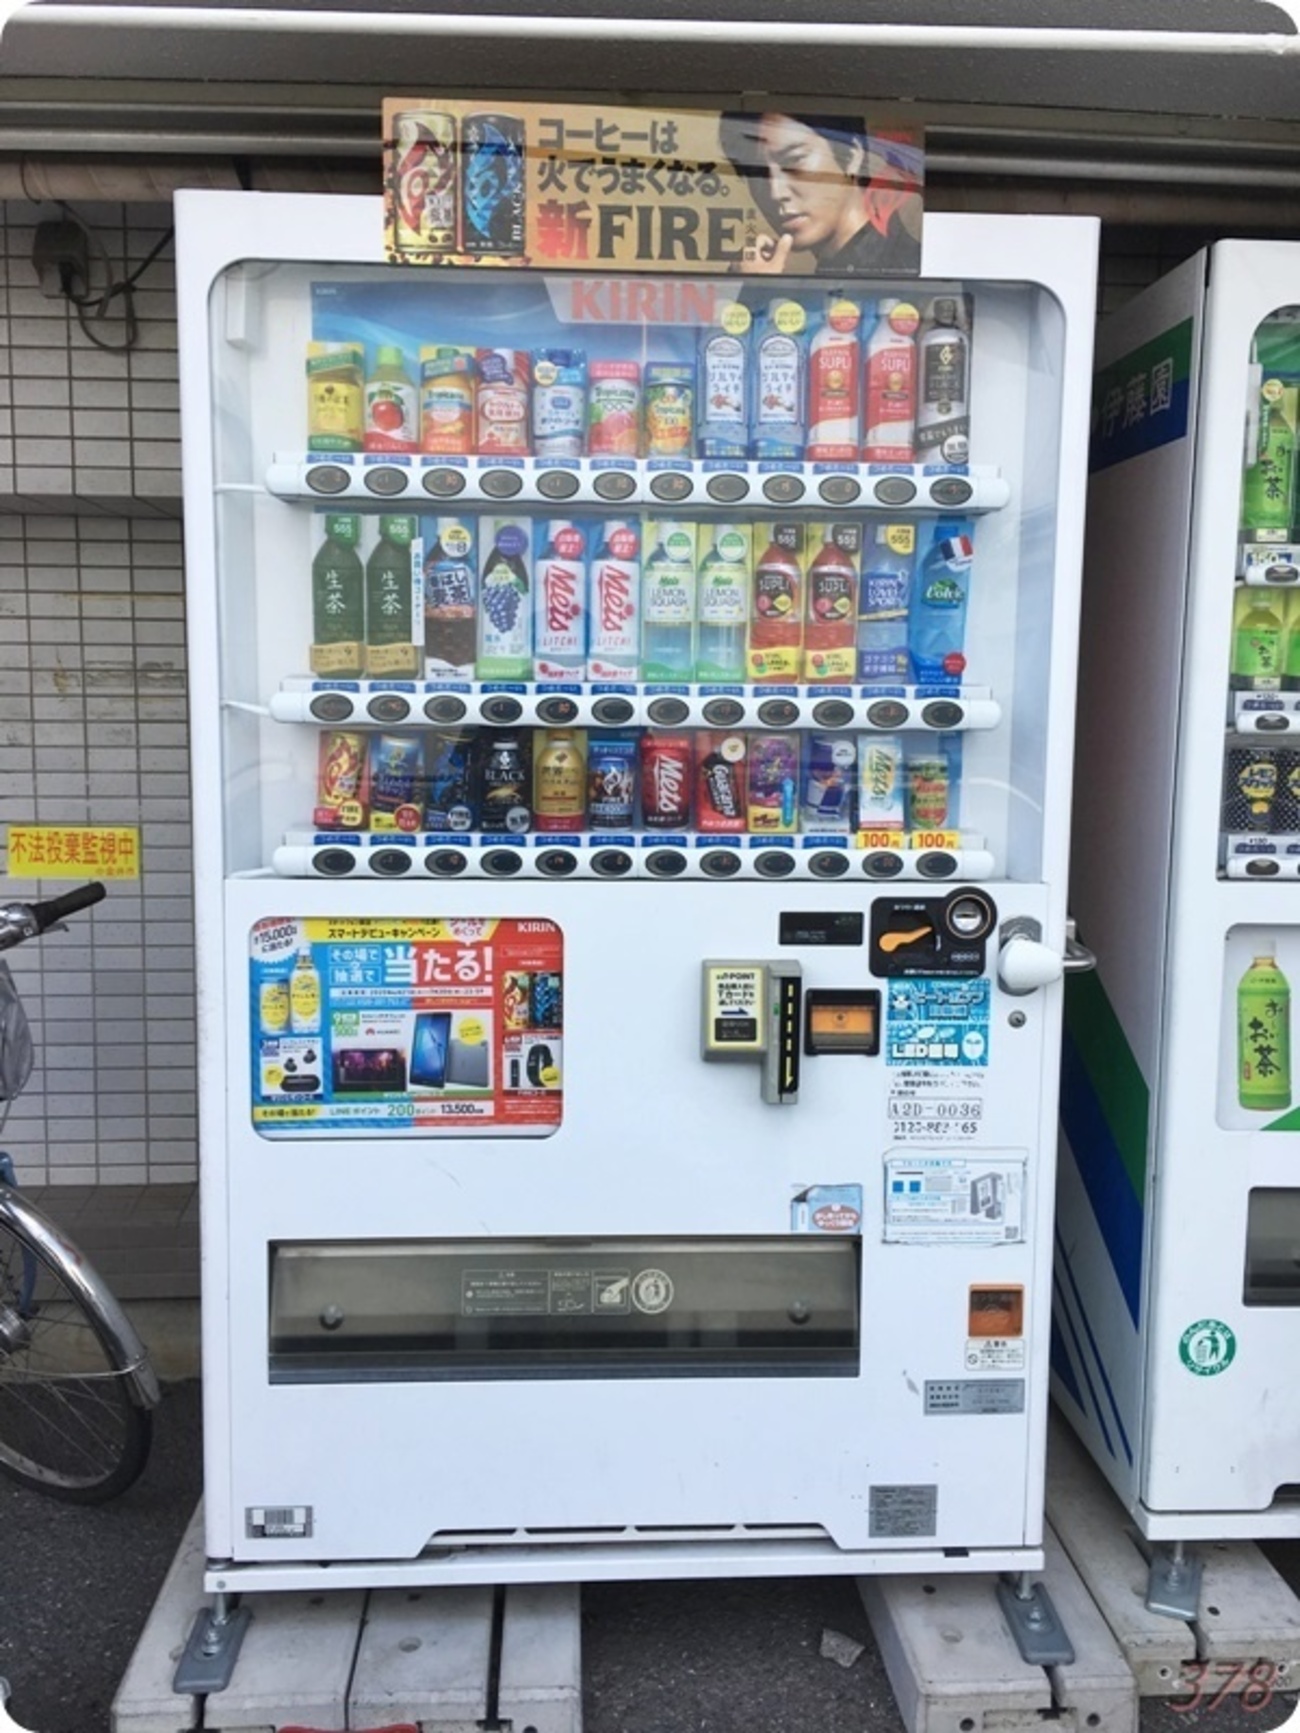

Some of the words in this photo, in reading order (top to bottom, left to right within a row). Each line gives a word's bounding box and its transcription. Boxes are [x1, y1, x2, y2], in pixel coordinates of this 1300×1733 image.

[538, 117, 679, 154] コーヒーは
[537, 155, 732, 198] 火でうまくなる。
[571, 280, 717, 323] KIRIN
[325, 569, 346, 615] 生茶
[381, 569, 402, 616] 生茶
[547, 564, 581, 632] Mets
[601, 564, 635, 632] Mets
[652, 587, 686, 599] LEMON
[484, 769, 525, 782] BLACK
[654, 753, 684, 813] Mets
[871, 748, 893, 797] Mets
[11, 831, 135, 865] 不法投棄監視中
[328, 927, 441, 939] スマートデビューキャンペーン
[516, 921, 557, 934] KIRIN
[331, 948, 378, 961] その場で
[384, 945, 494, 984] 当たる!
